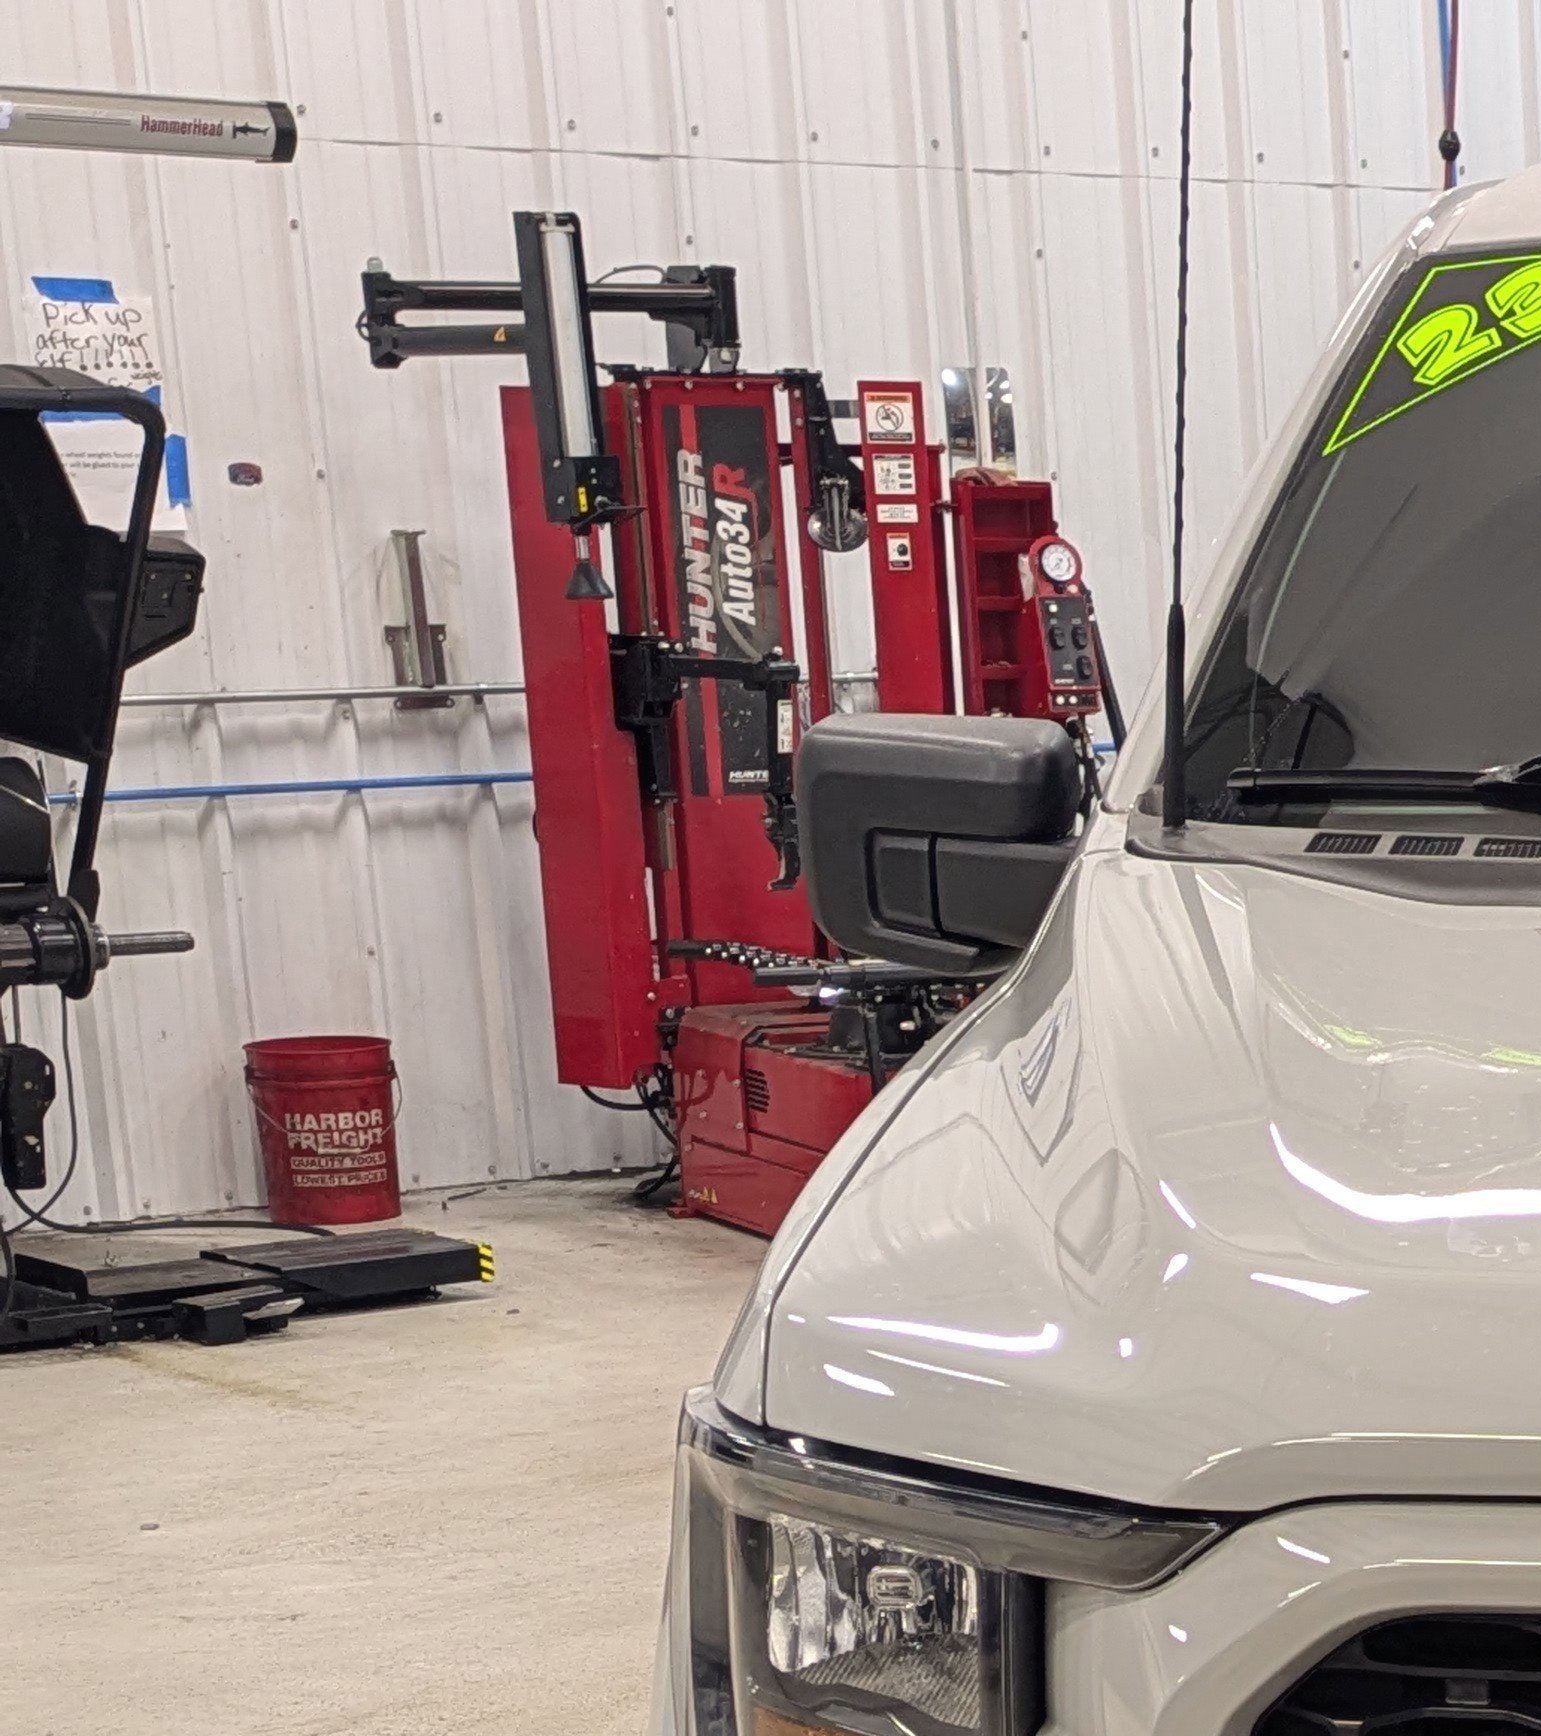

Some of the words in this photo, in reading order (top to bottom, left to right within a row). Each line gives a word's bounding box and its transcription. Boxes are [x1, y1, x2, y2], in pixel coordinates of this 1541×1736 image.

[140, 114, 223, 138] HammerHead
[42, 301, 98, 328] Pick
[105, 308, 142, 331] up
[36, 329, 99, 350] after
[102, 333, 150, 356] your
[677, 449, 718, 655] HUNTER
[711, 462, 756, 627] Auto34R
[730, 770, 770, 779] HUNTE
[285, 1108, 383, 1131] HARBOR
[287, 1127, 383, 1150] FREIGHT
[293, 1156, 344, 1169] QUALITY
[349, 1152, 385, 1168] TOOLS
[294, 1174, 343, 1186] LOWEST
